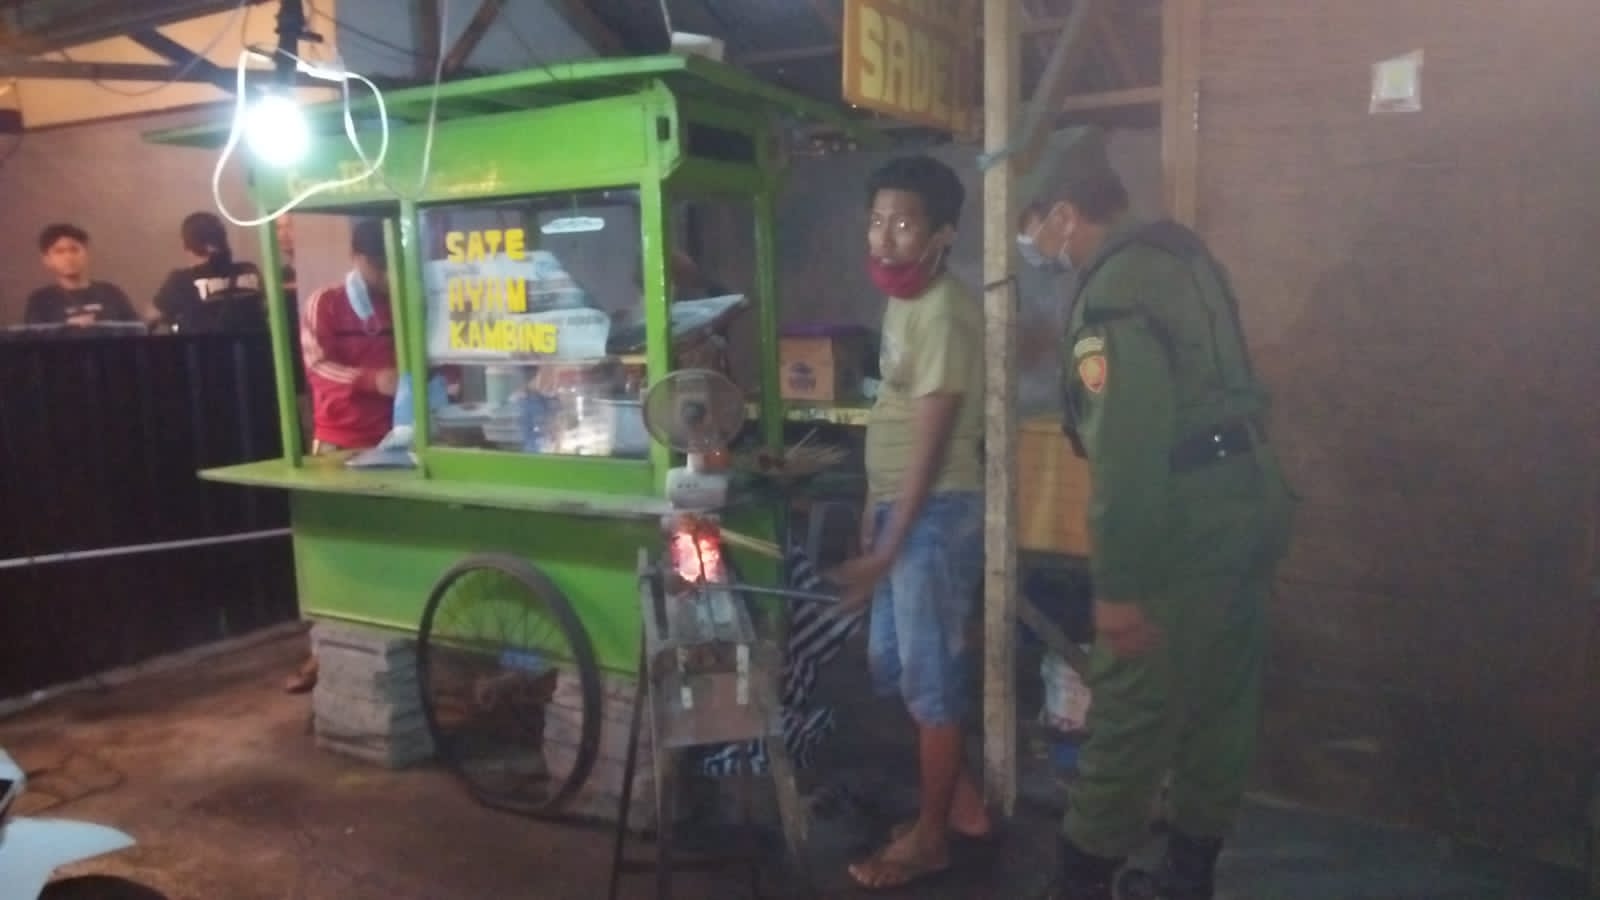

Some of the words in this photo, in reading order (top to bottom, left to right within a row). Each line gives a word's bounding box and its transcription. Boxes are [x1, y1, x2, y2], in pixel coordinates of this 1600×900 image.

[445, 228, 525, 264] SATE
[448, 277, 527, 313] AYAM
[449, 319, 558, 354] KAMBING
